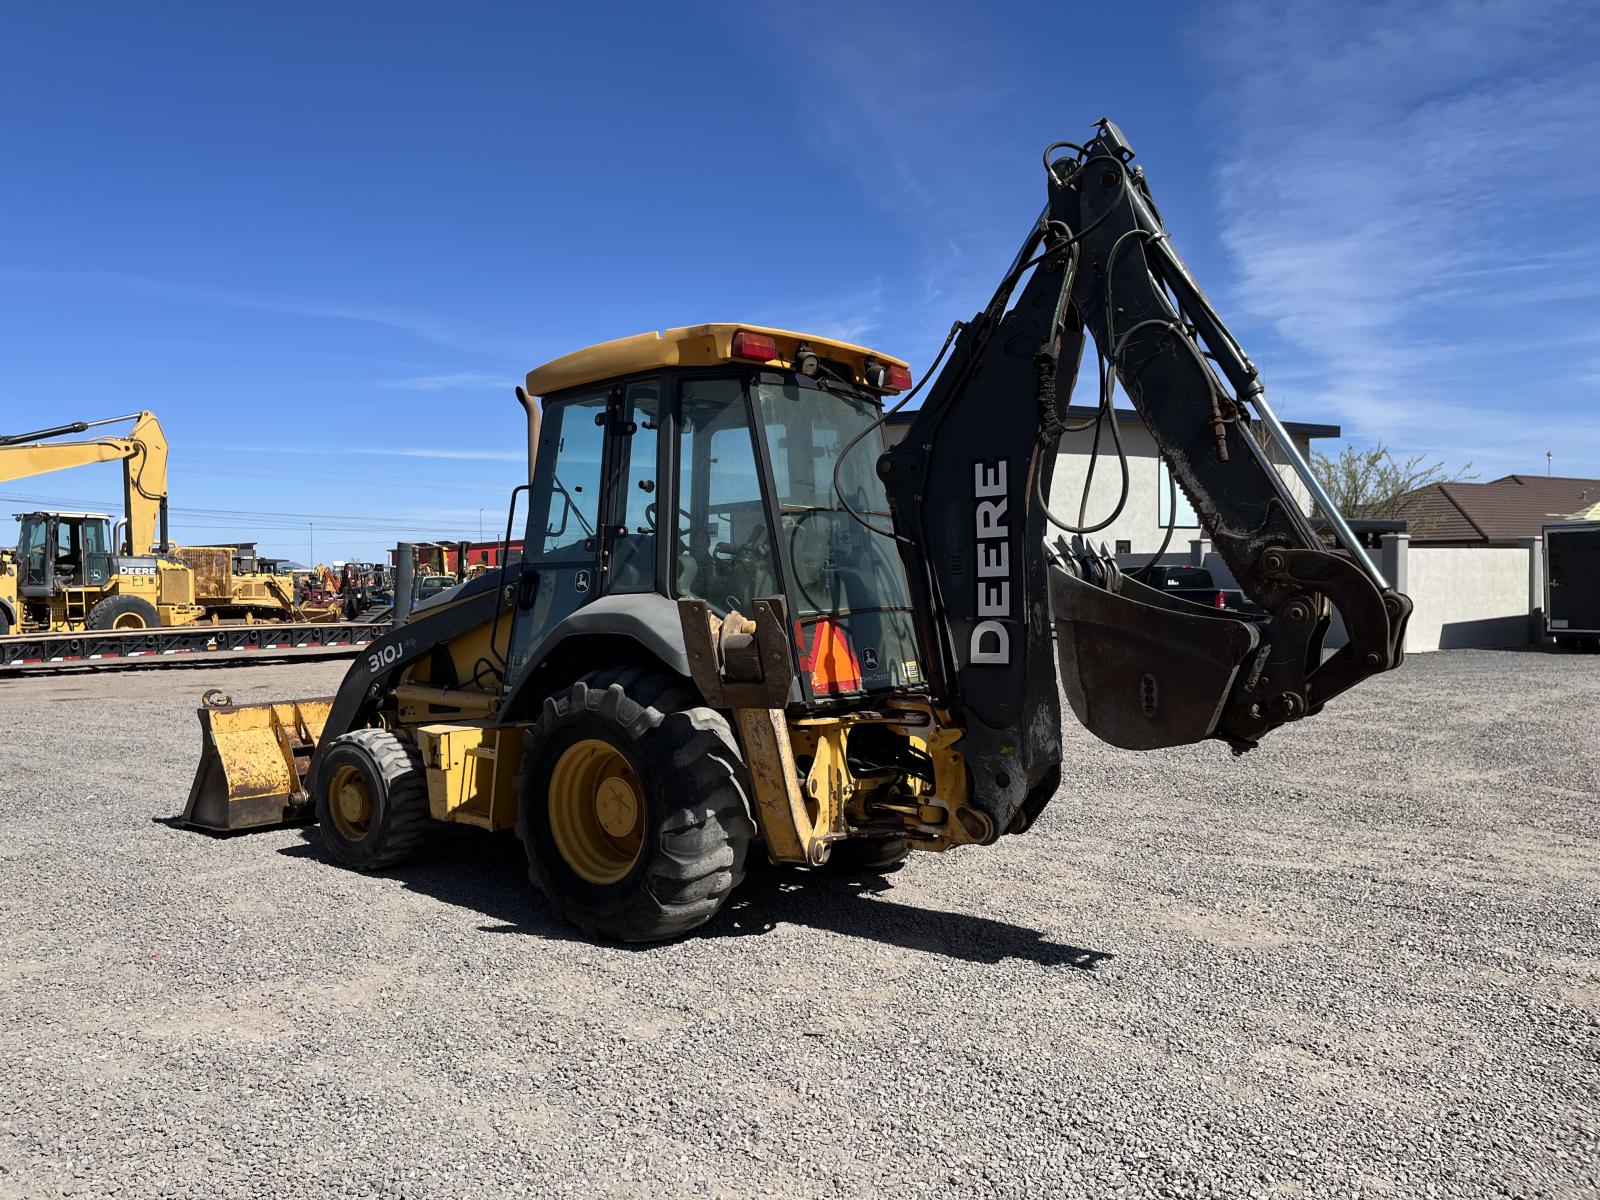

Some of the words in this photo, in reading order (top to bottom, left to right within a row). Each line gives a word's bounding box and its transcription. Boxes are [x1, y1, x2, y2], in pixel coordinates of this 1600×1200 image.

[119, 566, 156, 575] DEERE
[970, 460, 1010, 664] DEERE
[368, 641, 403, 673] 310J
